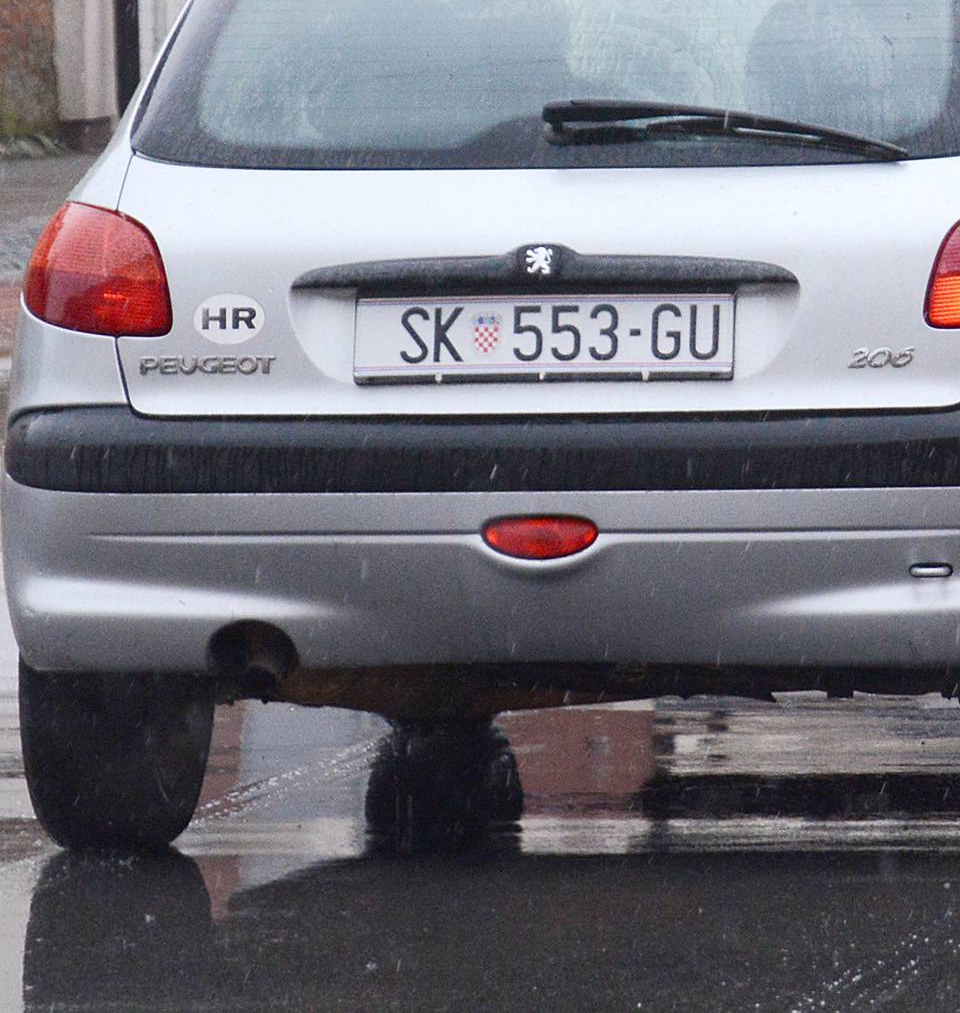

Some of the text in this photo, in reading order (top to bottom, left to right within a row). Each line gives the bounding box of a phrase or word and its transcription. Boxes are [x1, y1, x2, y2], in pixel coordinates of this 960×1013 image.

[202, 307, 256, 330] HR
[400, 303, 720, 364] SK 553-GU
[139, 354, 276, 376] PEUGEOT
[848, 346, 915, 369] 206
